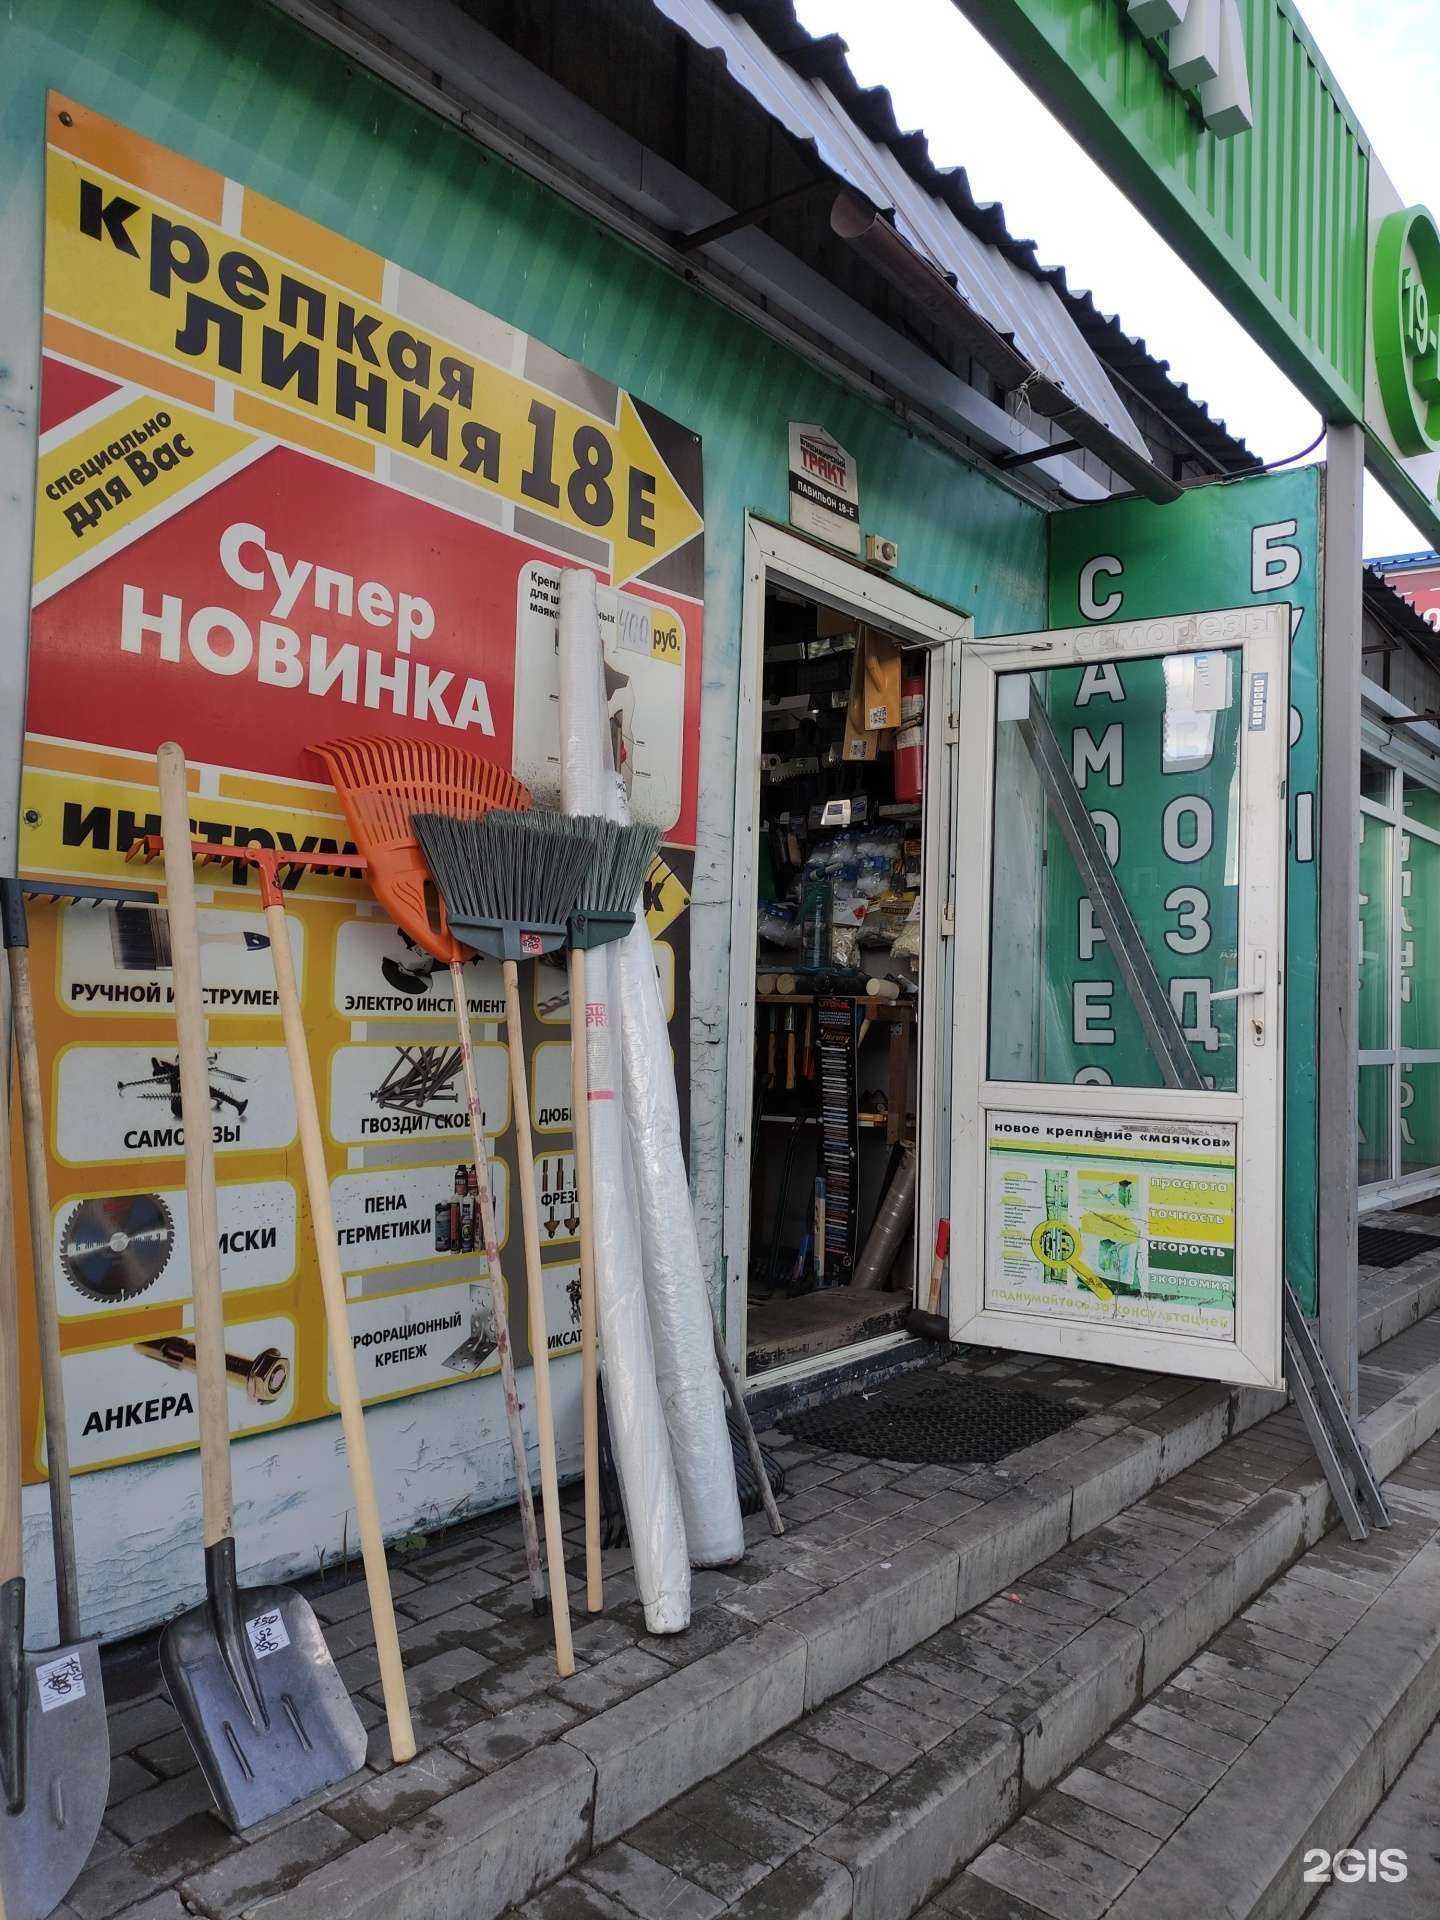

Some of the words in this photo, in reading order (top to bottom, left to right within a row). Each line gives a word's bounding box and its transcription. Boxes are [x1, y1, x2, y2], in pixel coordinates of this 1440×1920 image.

[80, 178, 474, 410] крепкая
[174, 292, 501, 484] линия
[45, 410, 172, 502] специально
[63, 474, 133, 538] для
[124, 432, 194, 490] Вас
[219, 522, 436, 653] Супер
[530, 571, 560, 590] Крепл
[530, 588, 549, 602] для
[653, 627, 681, 652] руб.
[121, 584, 496, 737] НОВИНКА
[71, 983, 161, 1003] РУЧНОЙ
[345, 996, 414, 1012] ЭЛЕКТРО
[361, 1115, 423, 1134] ГВОЗДИ
[994, 1122, 1040, 1136] новое
[1046, 1126, 1133, 1142] крепление
[1140, 1132, 1231, 1148] «маячков»
[1150, 1177, 1227, 1192] простота
[364, 1194, 408, 1214] ПЕНА
[1150, 1208, 1225, 1224] точность
[218, 1227, 277, 1254] ИСКИ
[337, 1218, 432, 1246] ГЕРМЕТИКИ
[1150, 1240, 1225, 1257] скорость
[1150, 1273, 1231, 1291] экономия
[375, 1343, 428, 1367] КРЕПЕЖ
[81, 1391, 194, 1438] АНКЕРА
